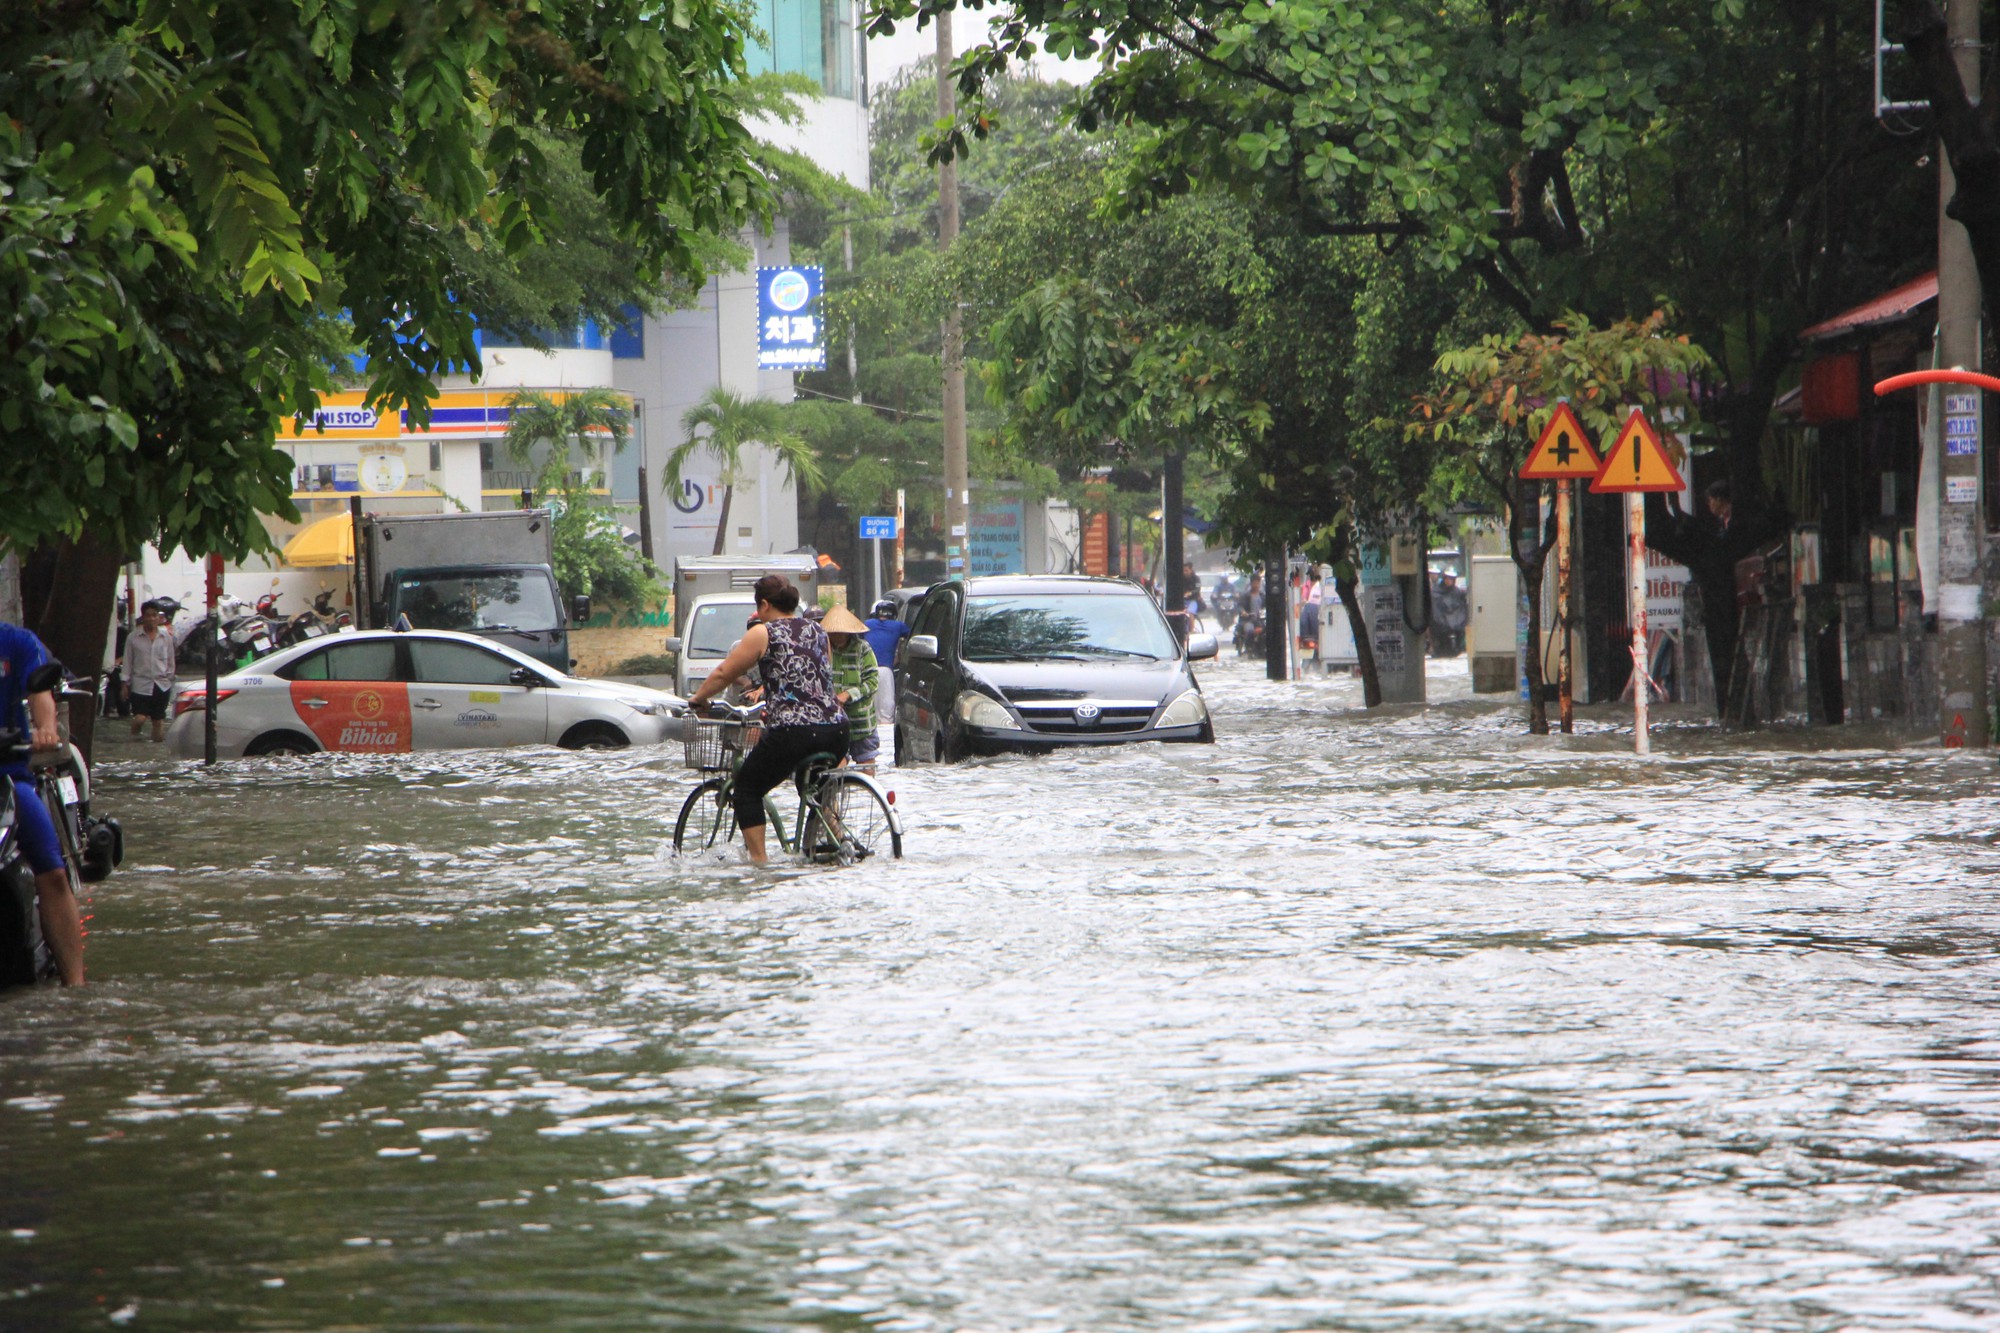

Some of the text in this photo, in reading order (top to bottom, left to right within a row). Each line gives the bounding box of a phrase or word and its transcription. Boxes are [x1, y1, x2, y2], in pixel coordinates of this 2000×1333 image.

[765, 315, 817, 344] 치과
[337, 411, 371, 424] STOP
[243, 678, 263, 686] 3706
[339, 728, 398, 745] Bibica
